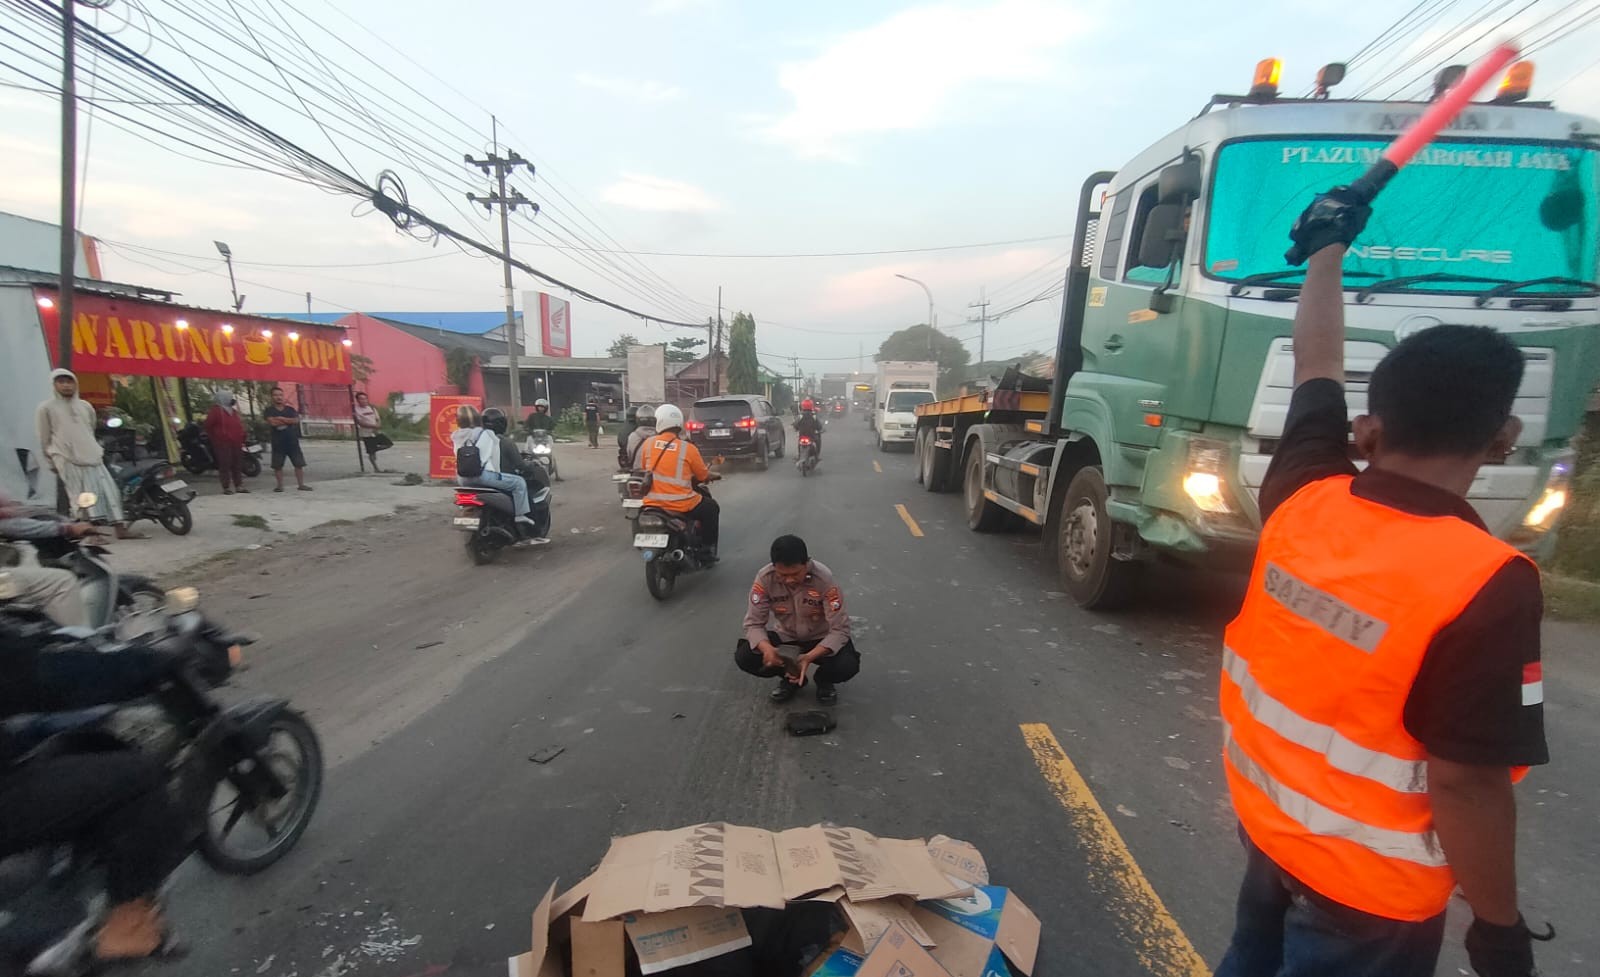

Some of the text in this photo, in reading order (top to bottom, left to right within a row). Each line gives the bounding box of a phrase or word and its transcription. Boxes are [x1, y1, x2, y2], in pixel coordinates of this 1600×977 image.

[1344, 245, 1513, 263] NSECURE
[72, 312, 346, 372] WARUNG KOPI
[1264, 566, 1374, 641] SAFETY
